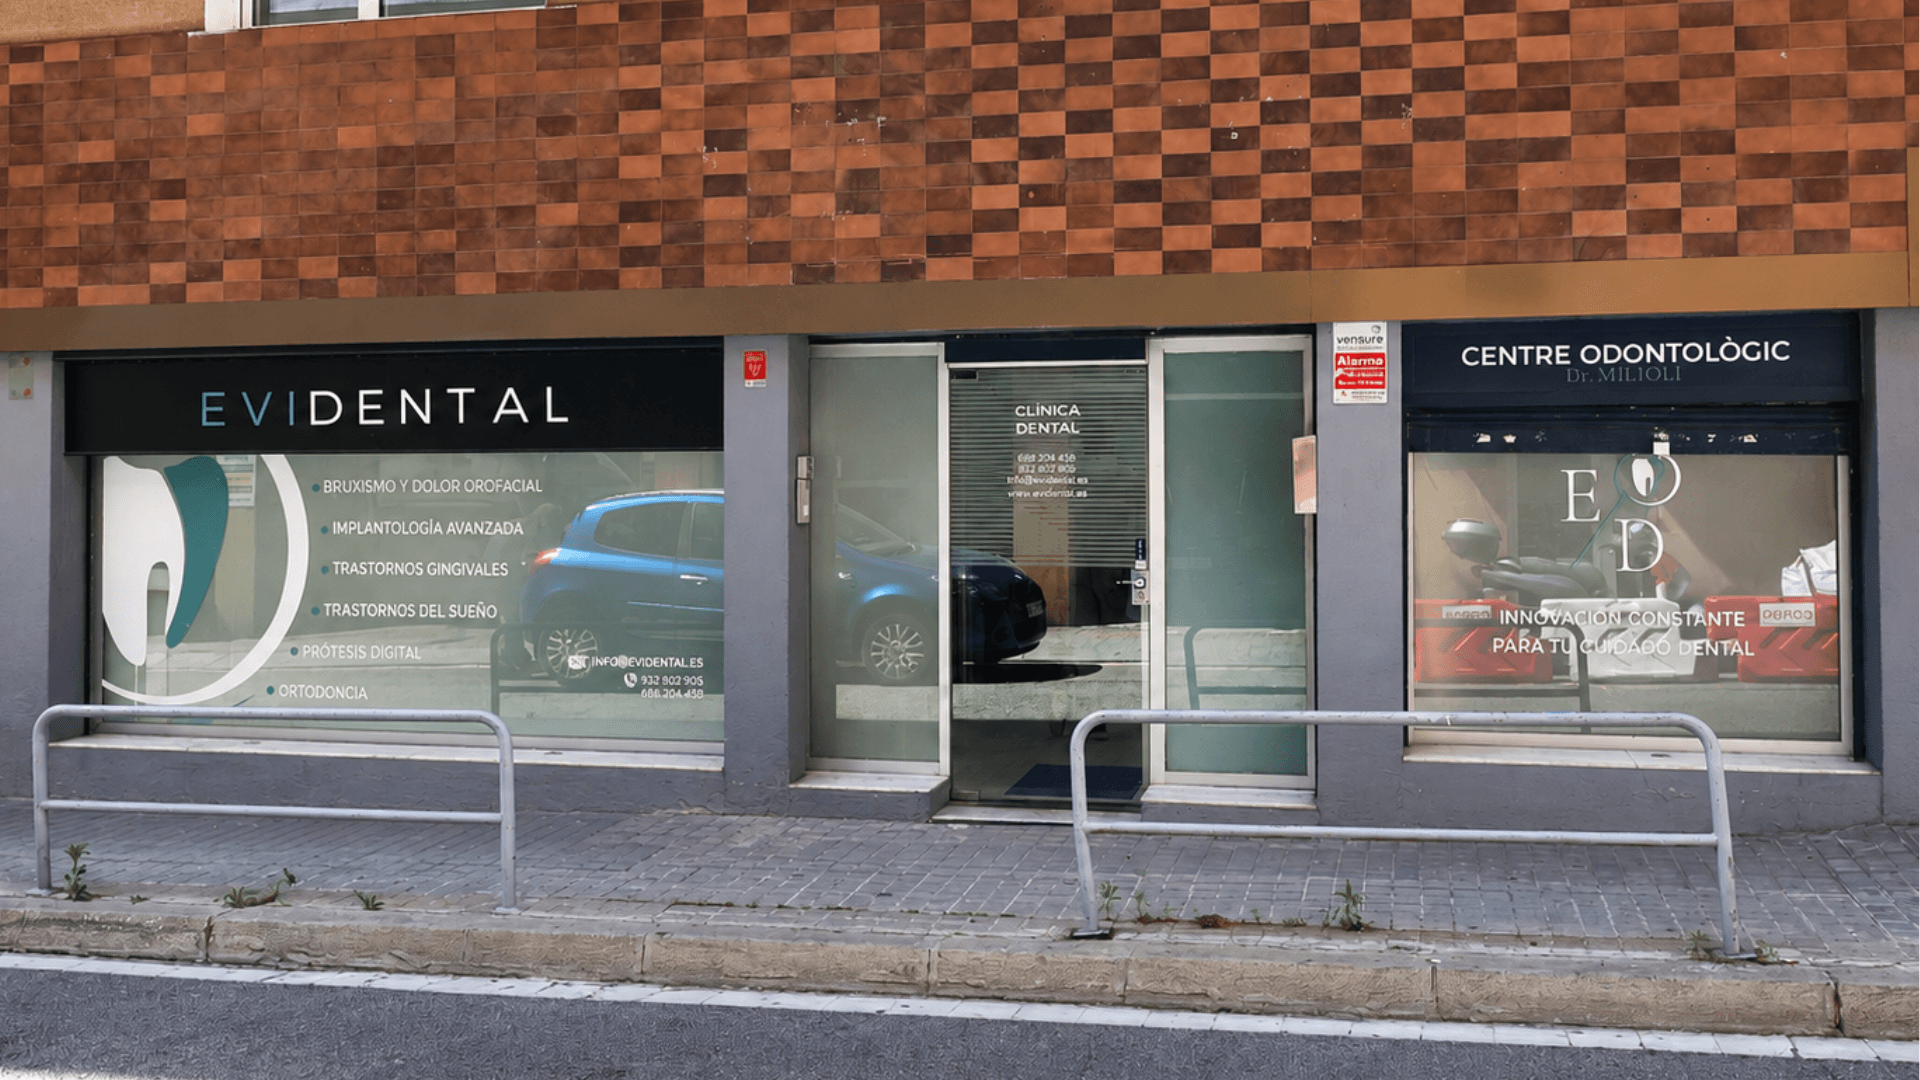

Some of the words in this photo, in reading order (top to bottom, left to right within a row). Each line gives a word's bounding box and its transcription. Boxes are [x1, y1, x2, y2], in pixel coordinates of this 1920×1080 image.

[1461, 345, 1571, 366] CENTRE
[1579, 336, 1790, 365] ODONTOLÒGIC
[1337, 355, 1383, 366] Alarma
[1566, 368, 1594, 383] Dr.
[1598, 366, 1681, 382] MILIOLI
[201, 386, 569, 427] EVIDENTAL
[1015, 402, 1081, 417] CLÍNICA
[1016, 422, 1080, 435] DENTAL
[323, 479, 396, 494] BRUXISMO
[399, 479, 409, 492] Y
[412, 479, 461, 493] DOLOR
[463, 479, 543, 493] OROFACIAL
[1560, 469, 1600, 522] E
[332, 519, 444, 535] IMPLANTOLOGÍA
[446, 521, 524, 535] AVANZADA
[1614, 518, 1664, 572] D
[332, 561, 424, 576] TRASTORNOS
[427, 562, 509, 577] GINGIVALES
[323, 603, 416, 617] TRASTORNOS
[419, 604, 446, 618] DEL
[448, 602, 498, 618] SUEÑO
[1628, 611, 1745, 627] CONSTANTE
[302, 642, 367, 659] PRÓTESIS
[370, 644, 422, 660] DIGITAL
[1493, 638, 1545, 654] PARA
[1548, 638, 1572, 654] TU
[1679, 640, 1755, 656] DENTAL
[278, 684, 368, 701] ORTODONCIA
